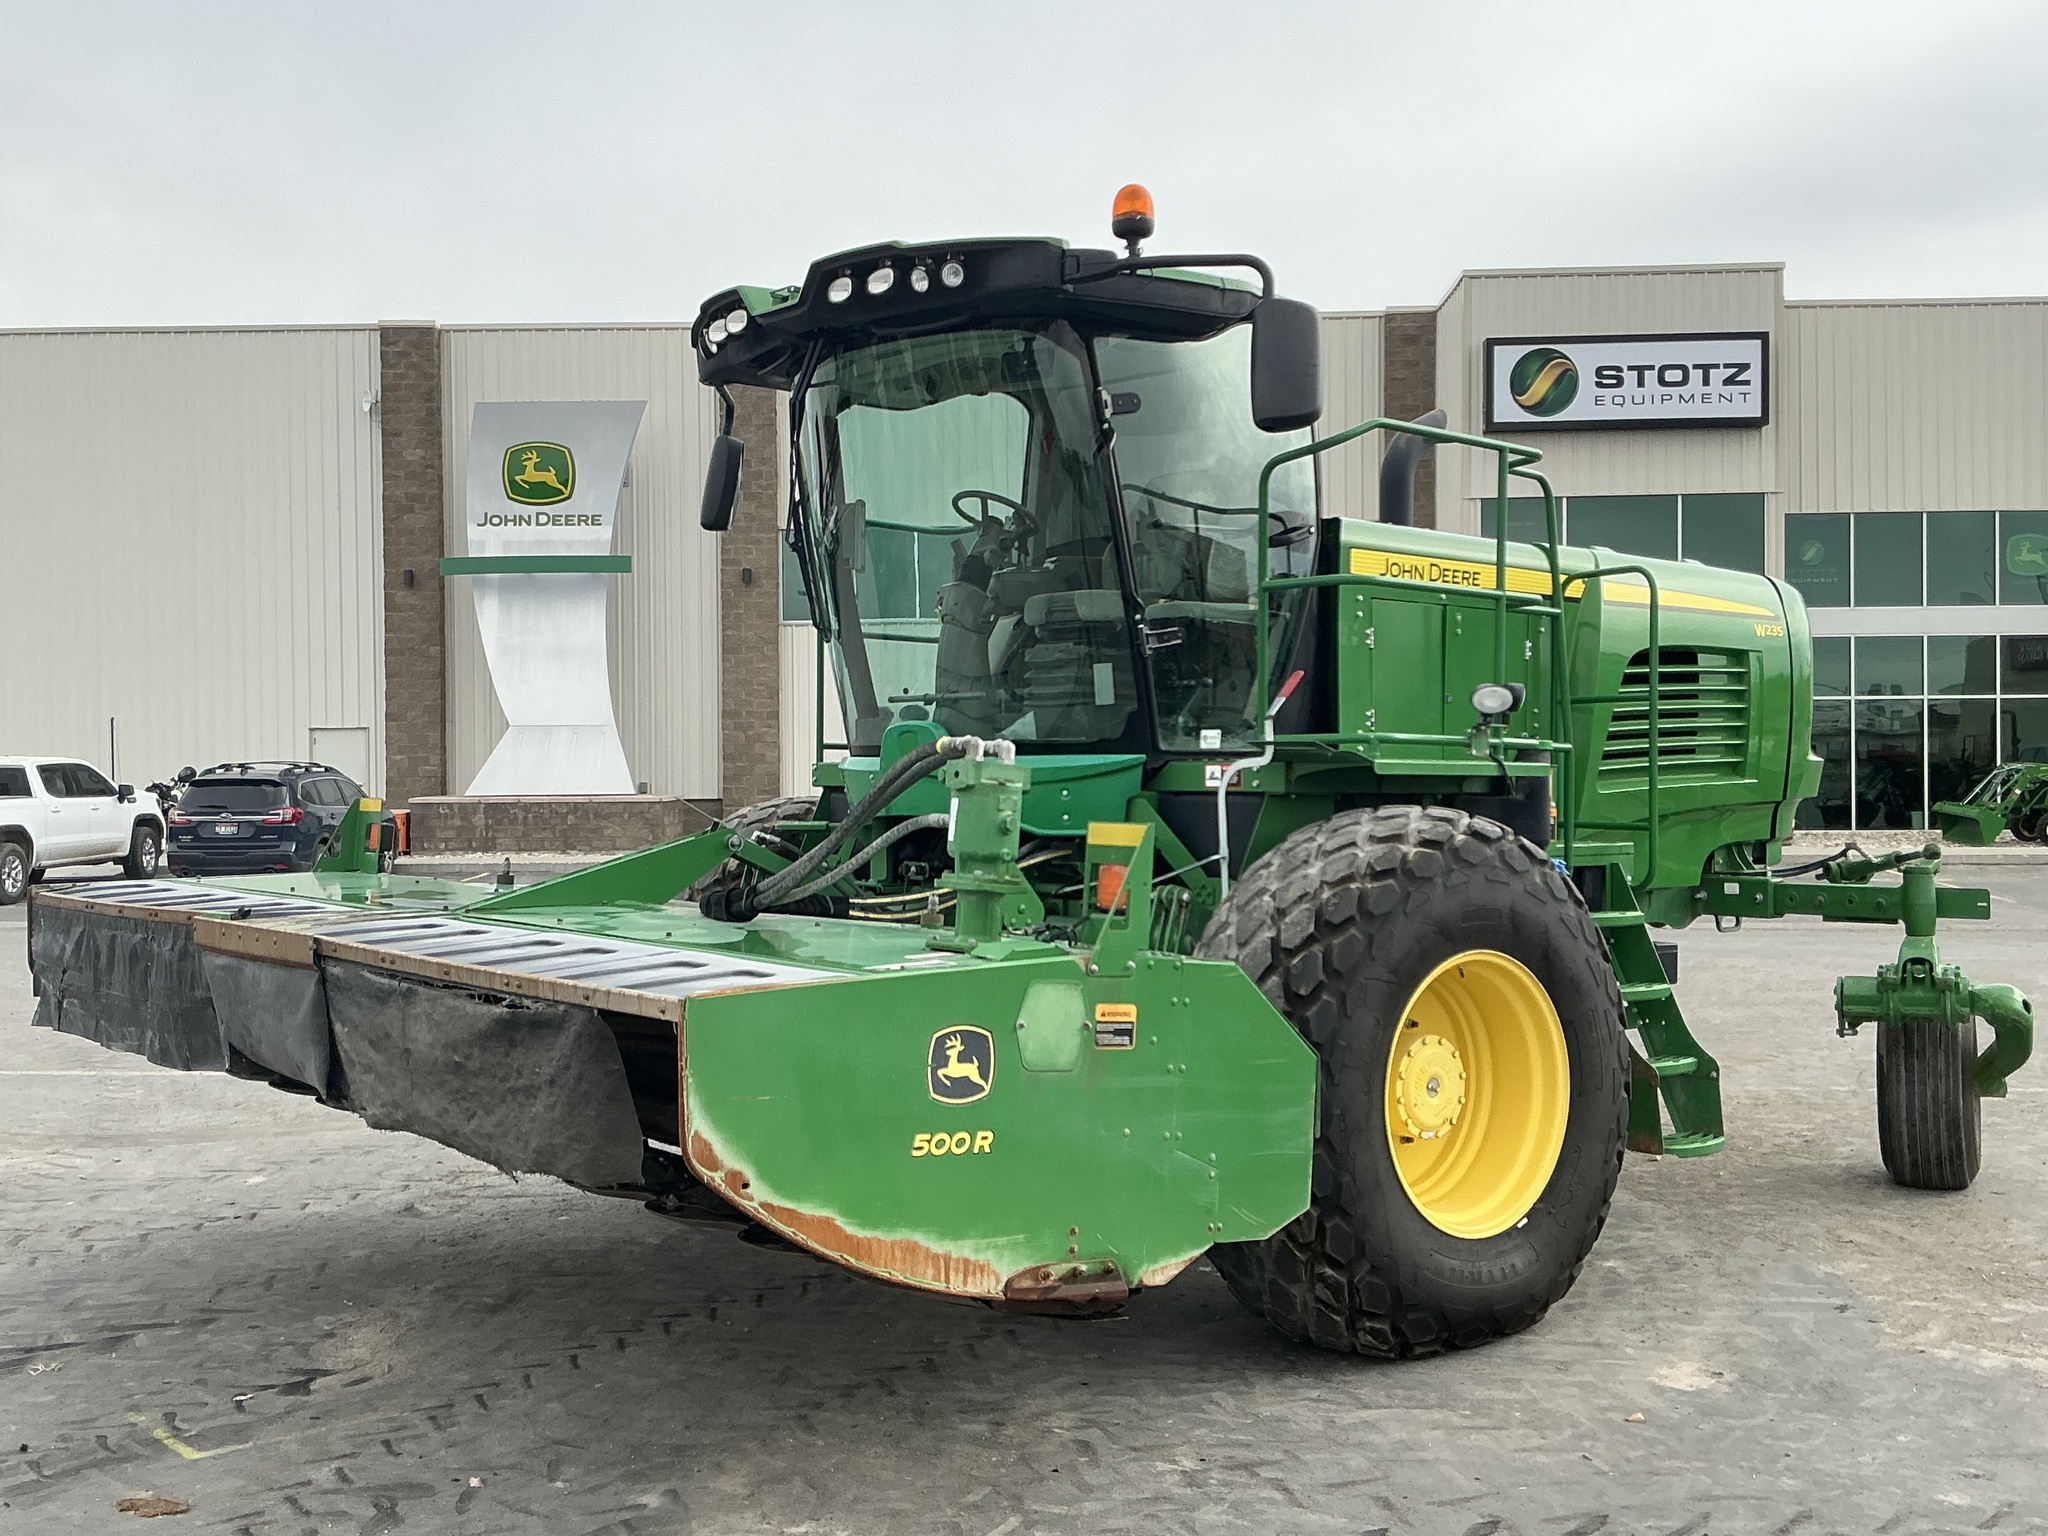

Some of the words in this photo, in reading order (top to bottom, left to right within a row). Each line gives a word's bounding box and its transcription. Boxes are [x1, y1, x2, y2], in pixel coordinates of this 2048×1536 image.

[1594, 362, 1752, 389] STOTZ
[1594, 392, 1752, 408] EQUIPMENT
[476, 511, 532, 527] JOHN
[535, 511, 603, 527] DEERE
[1379, 557, 1425, 581] JOHN
[1429, 562, 1482, 587] DEERE
[1753, 623, 1784, 637] W235
[910, 1130, 995, 1158] 500R
